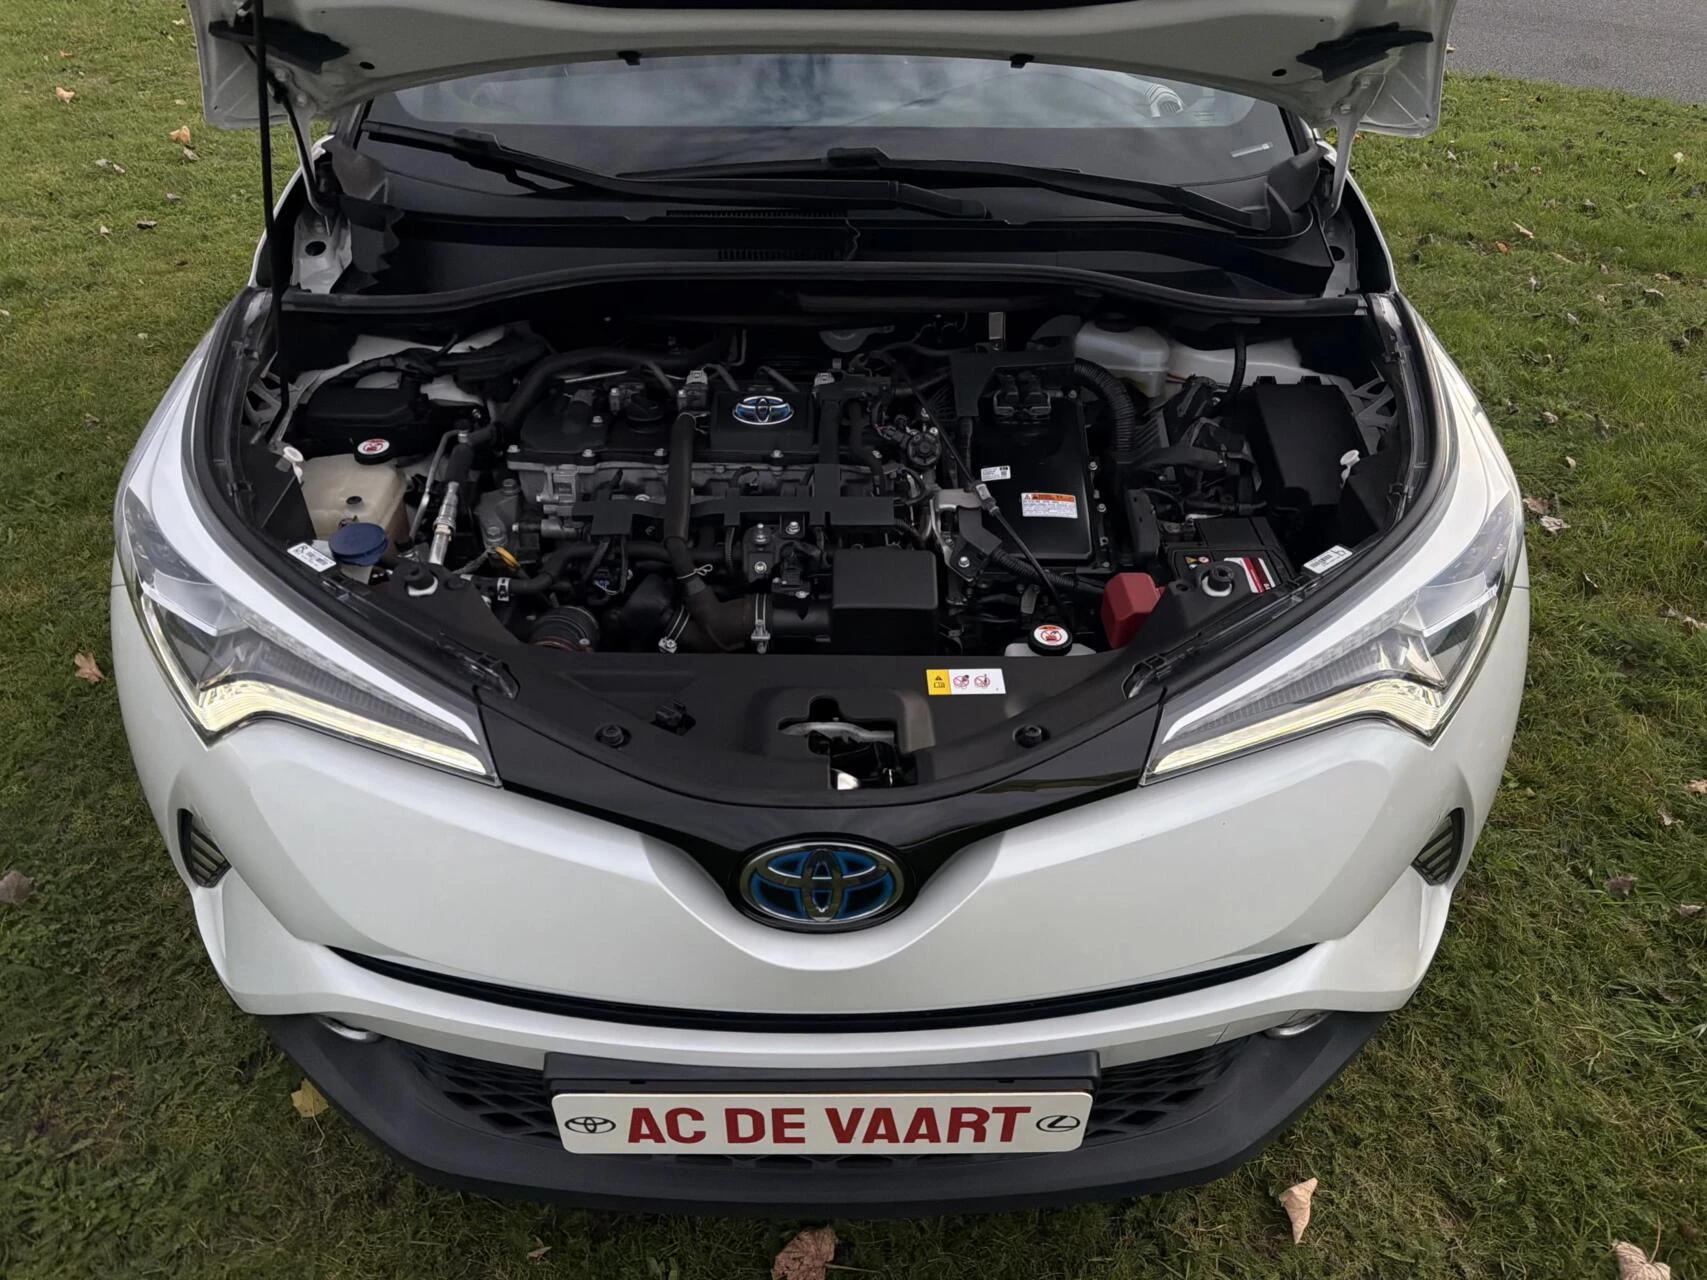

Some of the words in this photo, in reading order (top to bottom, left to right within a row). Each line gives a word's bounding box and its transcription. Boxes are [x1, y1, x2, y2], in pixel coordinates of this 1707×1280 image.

[628, 1107, 706, 1144] AC
[724, 1107, 806, 1144] DE
[825, 1106, 1031, 1144] VAART
